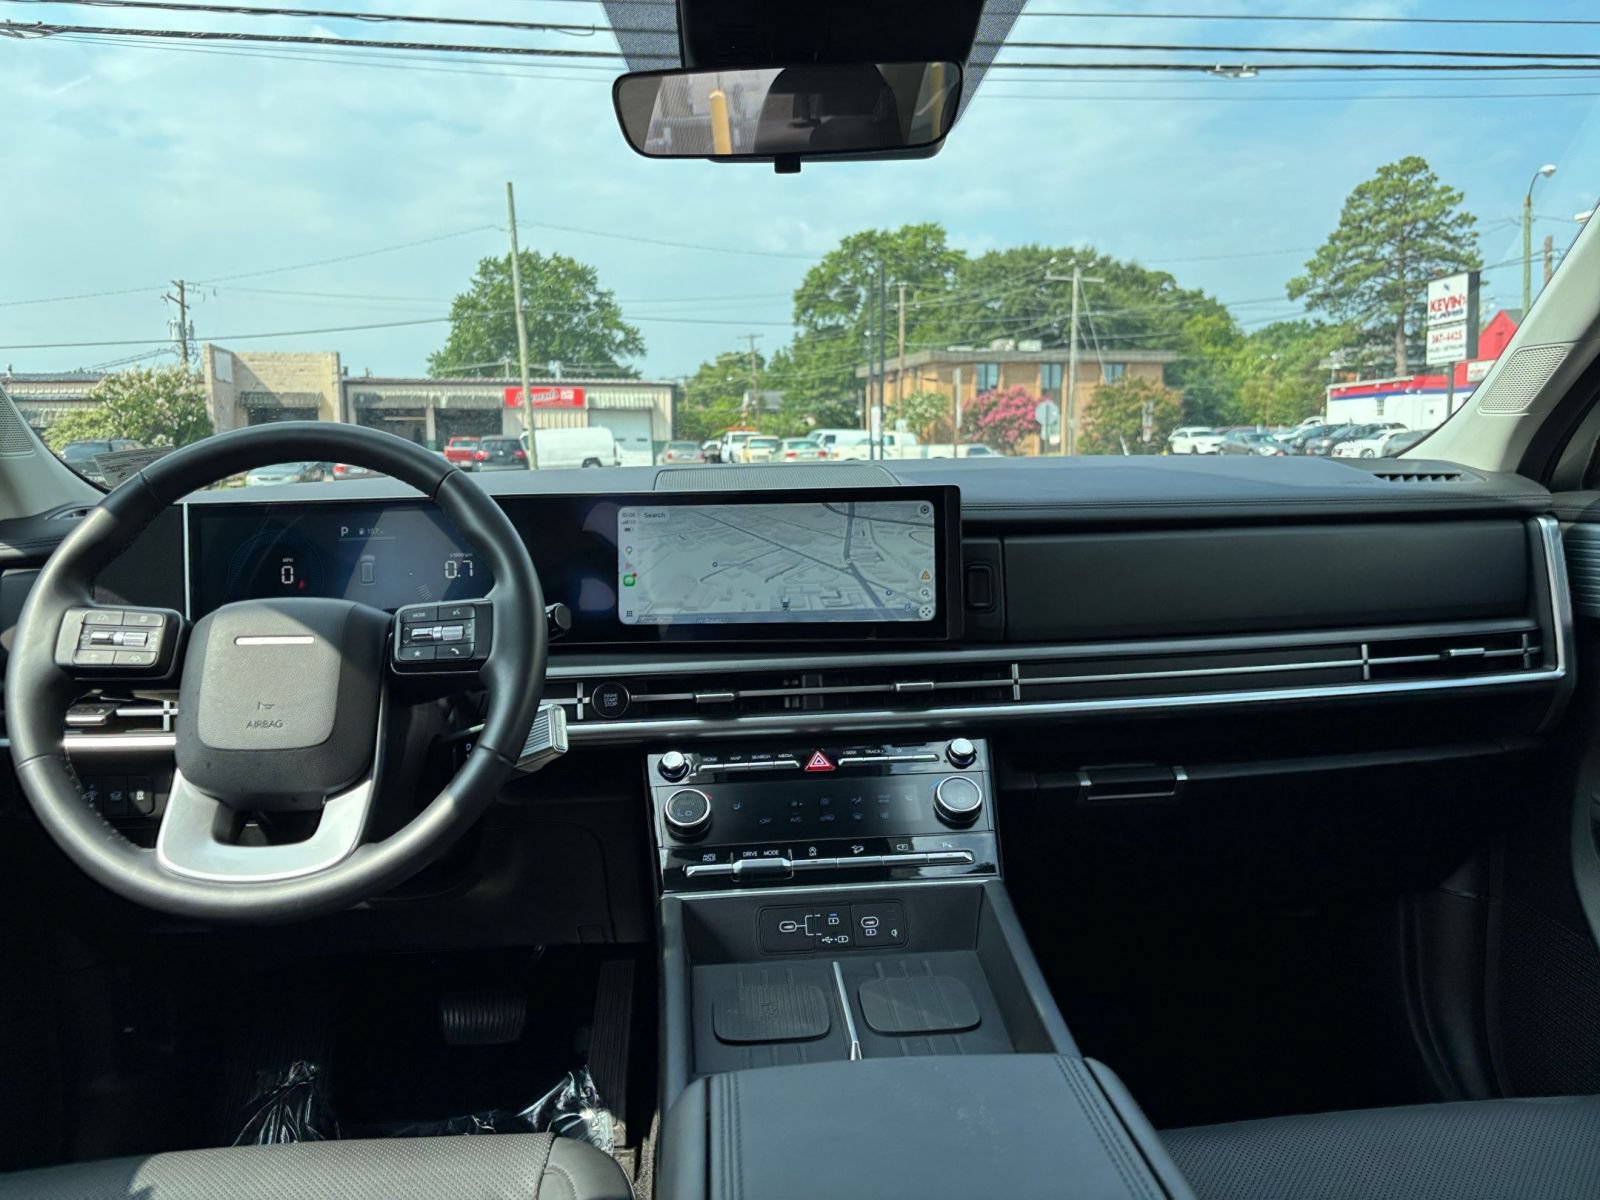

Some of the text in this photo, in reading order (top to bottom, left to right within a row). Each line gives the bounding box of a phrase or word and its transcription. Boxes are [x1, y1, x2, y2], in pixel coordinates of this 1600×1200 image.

[644, 511, 666, 519] Search
[340, 526, 349, 537] P
[281, 565, 294, 585] 0
[444, 560, 474, 579] 0.7
[246, 719, 284, 729] AIRBAG
